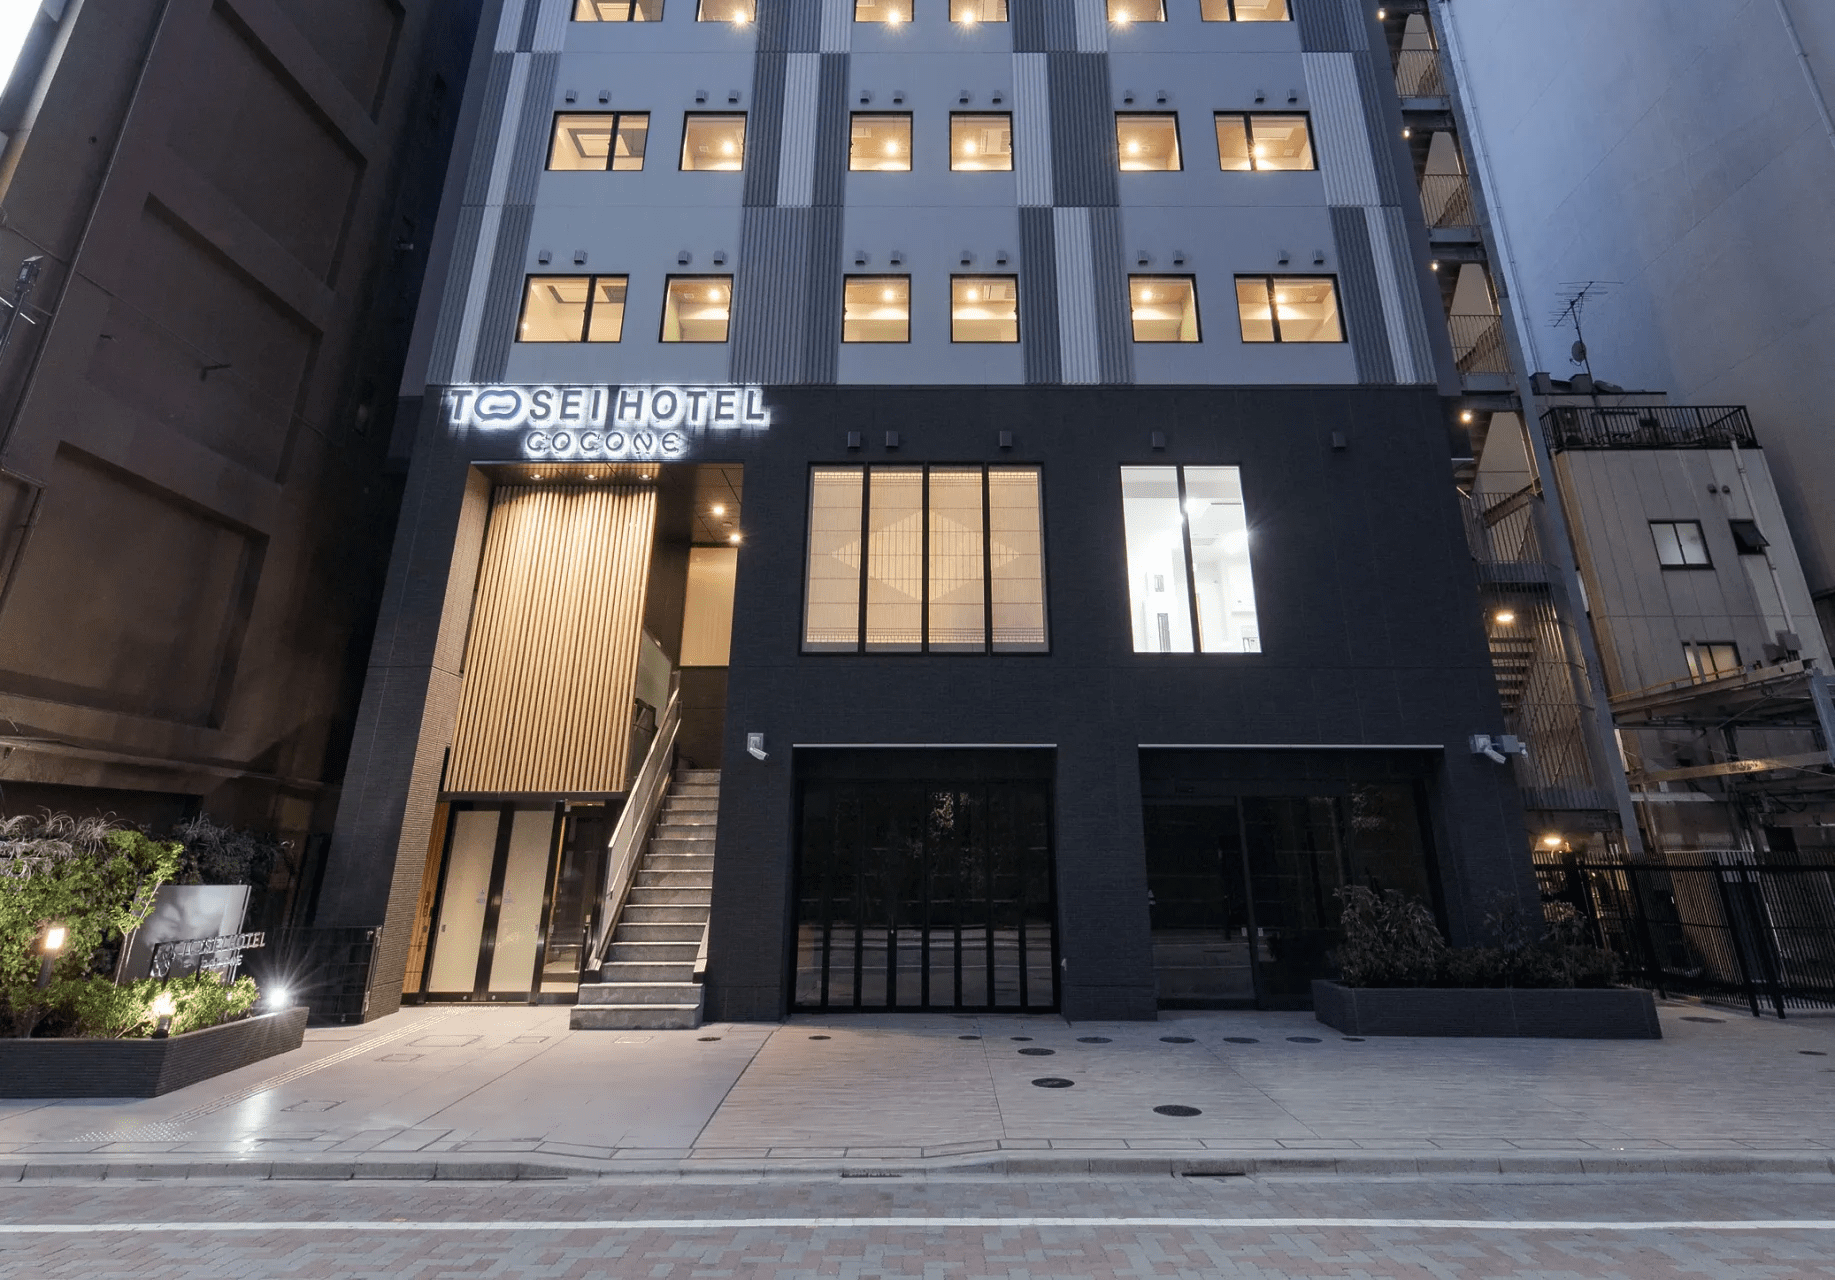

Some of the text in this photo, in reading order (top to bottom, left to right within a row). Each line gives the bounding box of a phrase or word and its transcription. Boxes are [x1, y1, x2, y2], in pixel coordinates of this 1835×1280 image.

[450, 389, 766, 421] TOSEI HOTEL
[526, 430, 682, 452] COCONE
